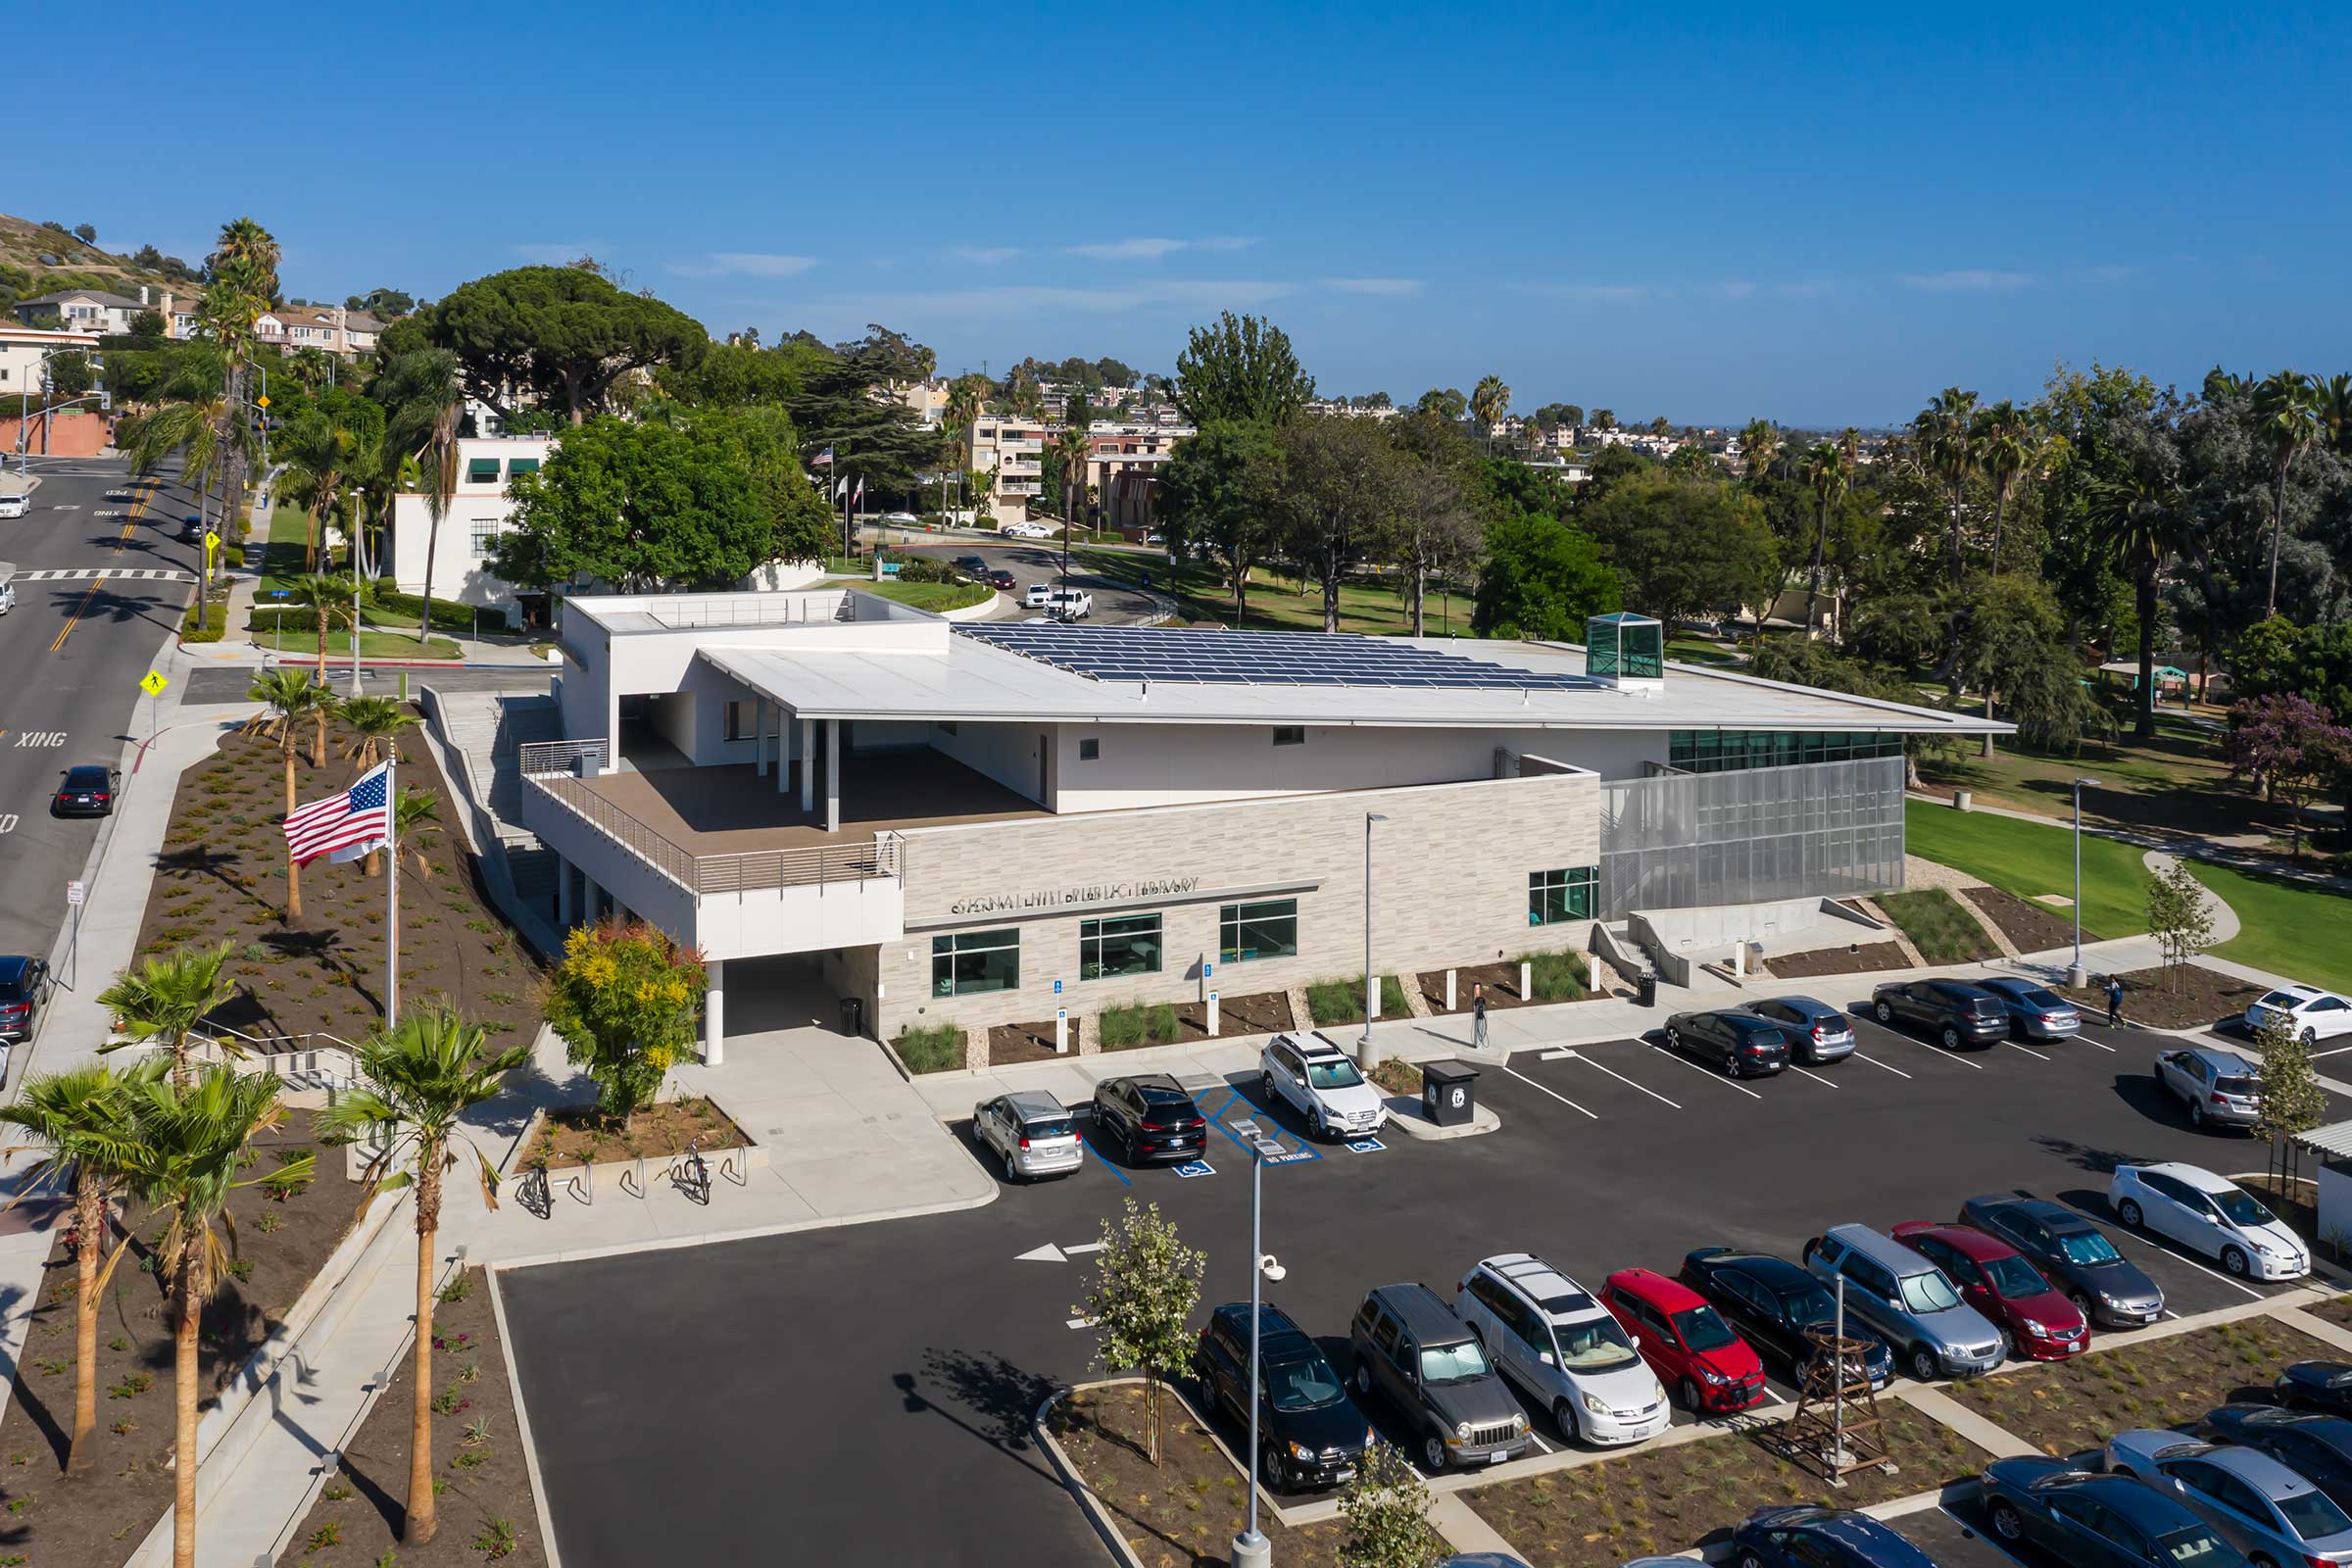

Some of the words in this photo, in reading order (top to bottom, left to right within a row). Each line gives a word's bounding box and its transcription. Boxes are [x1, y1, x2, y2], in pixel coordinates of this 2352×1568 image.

[14, 731, 68, 748] XING
[957, 893, 1022, 913] SIGNAL
[1031, 889, 1065, 906] HILL
[1072, 883, 1128, 903] PUBLIC
[1136, 877, 1199, 897] LIBRARY
[1279, 1152, 1313, 1162] PARKING
